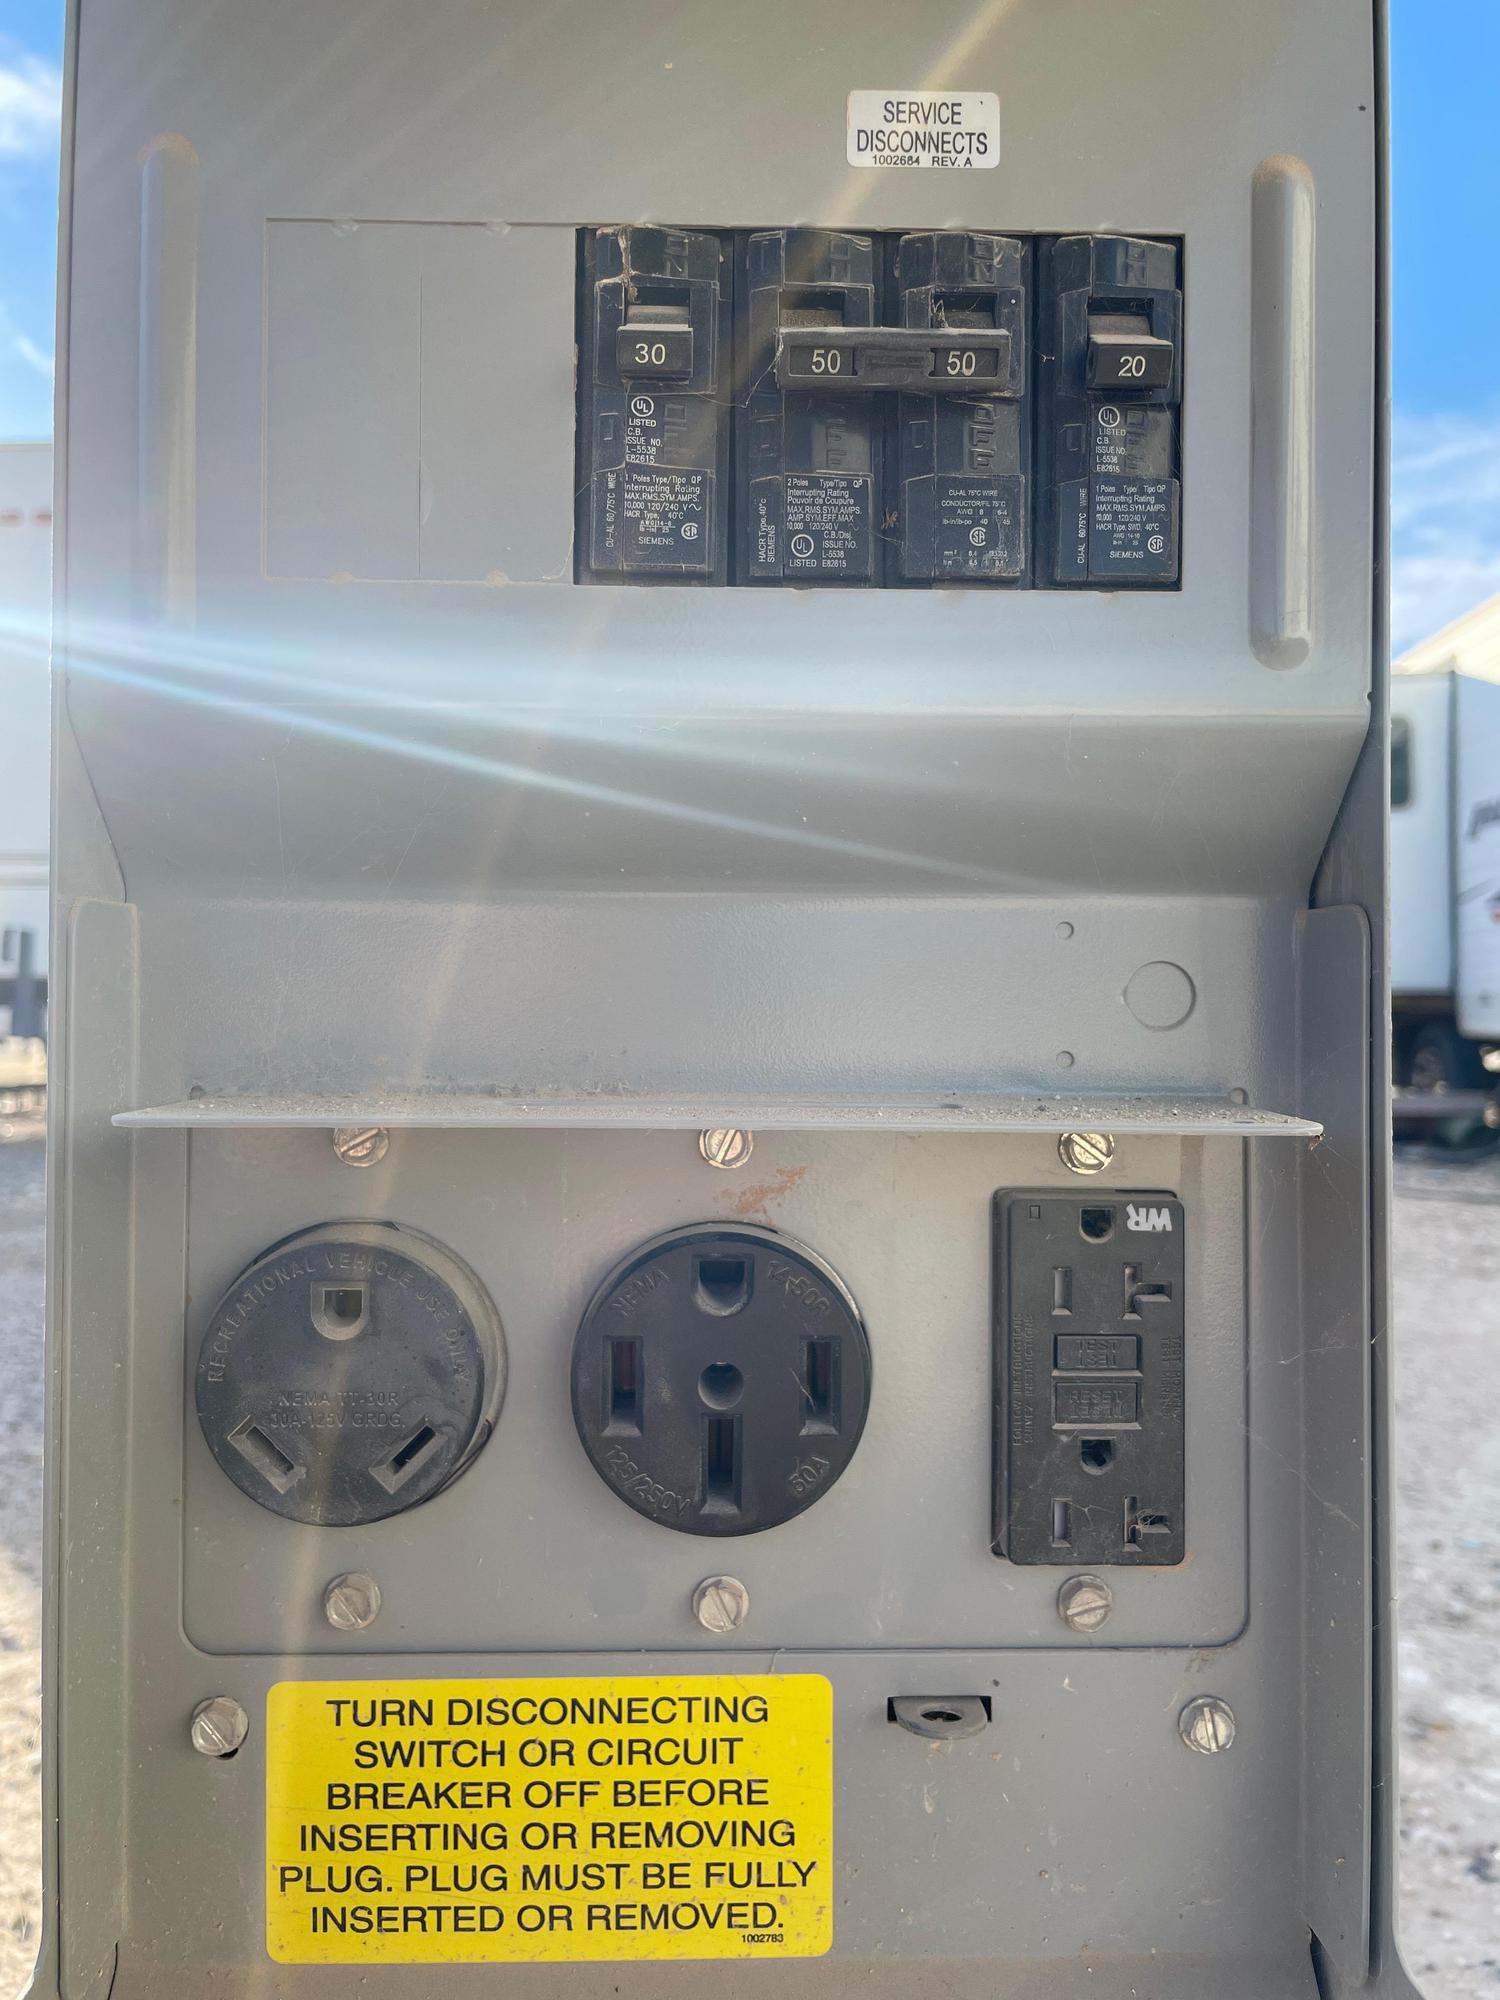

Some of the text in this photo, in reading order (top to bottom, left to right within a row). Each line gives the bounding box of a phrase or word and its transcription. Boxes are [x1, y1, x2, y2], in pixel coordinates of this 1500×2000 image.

[883, 101, 962, 124] SERVICE
[857, 130, 988, 155] DISCONNECTS
[872, 155, 972, 167] 1002684 REV. A
[634, 343, 666, 365] 30
[811, 349, 840, 374] 50
[946, 351, 976, 376] 50
[1118, 355, 1145, 377] 20
[629, 418, 656, 427] LISTED
[628, 428, 642, 436] C.B.
[1099, 428, 1126, 436] LISTED
[626, 437, 662, 447] ISSUE NO.
[626, 446, 656, 454] L-5538
[626, 455, 655, 464] E82615
[1097, 455, 1117, 463] L-5538
[1097, 465, 1120, 473] E82615
[608, 472, 616, 489] WIRE
[633, 474, 650, 482] Poles
[652, 475, 686, 484] Type/Tipo
[820, 480, 847, 488] Type/Tipo
[624, 483, 700, 494] Interrupting Rating
[788, 489, 849, 498] Interrupting Rating
[825, 497, 854, 505] Coupure
[1096, 495, 1132, 504] Interrupting
[624, 501, 644, 510] 10,000
[648, 502, 679, 512] 120/240
[624, 510, 640, 518] HACR
[787, 522, 803, 531] 10,000
[809, 522, 832, 530] 120/240
[1096, 523, 1112, 531] HACR
[606, 525, 614, 547] CU-AL
[639, 537, 674, 545] SIEMENS
[767, 525, 775, 563] SIEMENS
[822, 550, 844, 558] L-5538
[1126, 1203, 1173, 1231] WR
[612, 1268, 670, 1318] NEMA
[208, 1253, 472, 1383] RECREATIONAL VEHICLE USE ONLY
[1076, 1339, 1118, 1352] TEST
[278, 1391, 399, 1407] NEMA TT-30R
[1071, 1391, 1122, 1403] RESET
[788, 1456, 830, 1493] 50A
[605, 1445, 692, 1517] 125/250V
[327, 1696, 768, 1728] TURN DISCONNECTING
[354, 1738, 743, 1769] SWITCH OR CIRCUIT
[328, 1778, 768, 1810] BREAKER OFF BEFORE
[300, 1819, 796, 1852] INSERTING OR REMOVING
[279, 1861, 816, 1894] PLUG. PLUG MUST BE FULLY
[312, 1902, 785, 1933] INSERTED OR REMOVED.
[742, 1934, 784, 1943] 1002783
